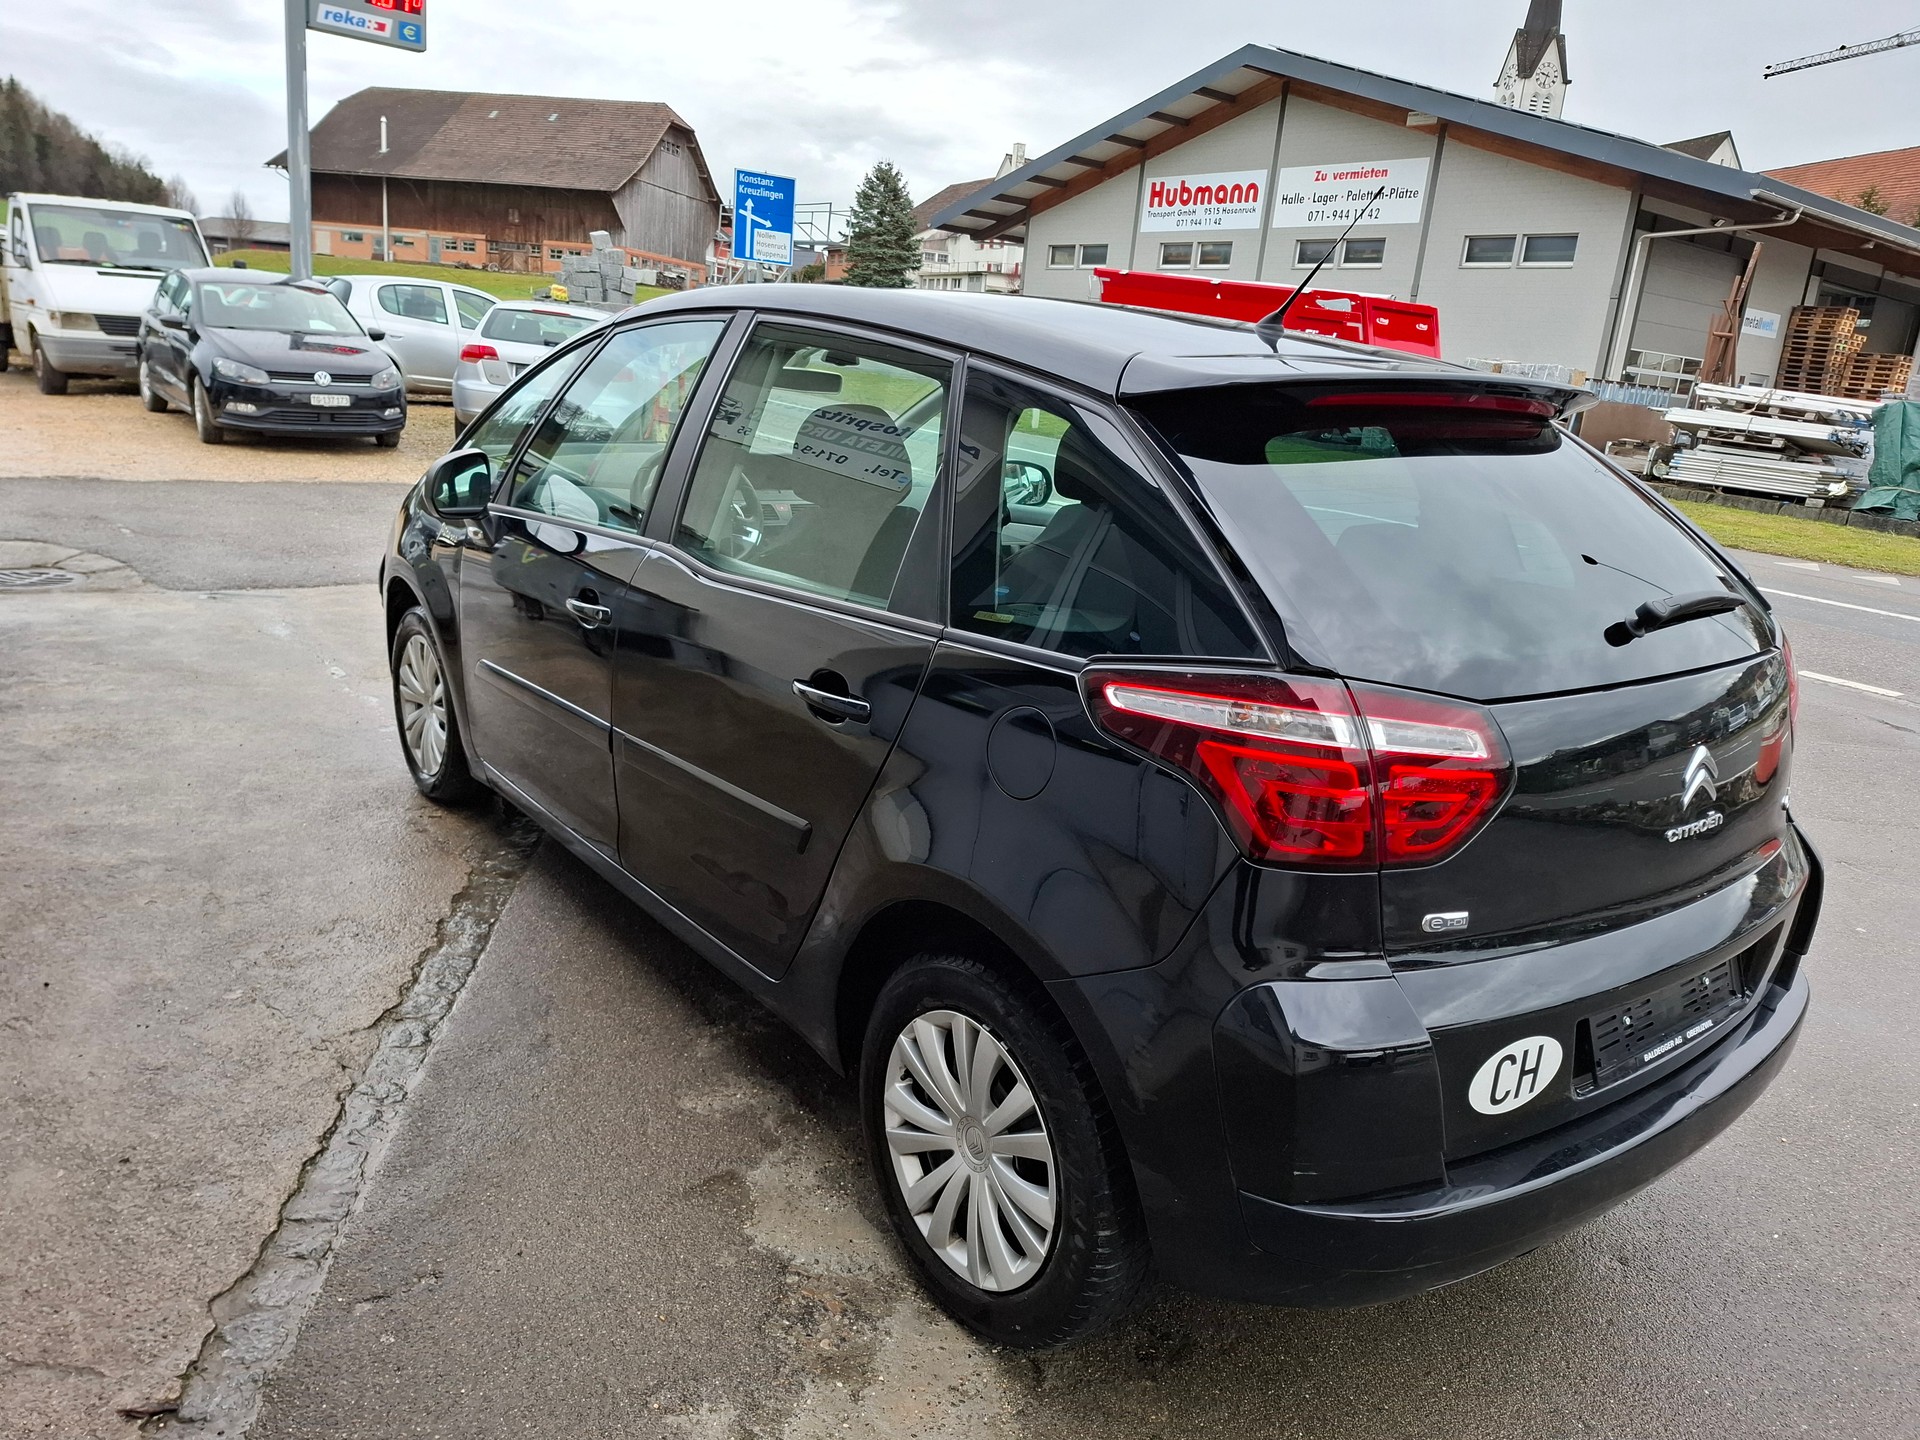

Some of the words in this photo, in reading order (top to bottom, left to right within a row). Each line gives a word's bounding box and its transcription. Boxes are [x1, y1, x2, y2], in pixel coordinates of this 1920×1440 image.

[740, 173, 774, 187] Konstanz
[1314, 170, 1327, 182] Zu
[1333, 166, 1389, 180] vermieten
[739, 184, 784, 200] Kreuzlingen
[1149, 180, 1259, 208] Hubmann
[1281, 193, 1305, 205] Halle
[1312, 192, 1338, 206] Lager
[1147, 210, 1176, 219] Transport
[1177, 209, 1197, 217] GmbH
[1204, 207, 1220, 216] 9515
[1367, 207, 1380, 220] 42
[1176, 219, 1188, 227] 071
[1190, 218, 1202, 226] 944
[1204, 218, 1212, 226] 11
[1213, 217, 1222, 226] 42
[756, 231, 777, 240] Nollen
[756, 240, 787, 250] Hosenruck
[756, 249, 788, 260] Wuppenau
[1643, 1039, 1675, 1062] BALDEGGER
[1674, 1035, 1683, 1046] AG
[1489, 1044, 1545, 1107] CH
